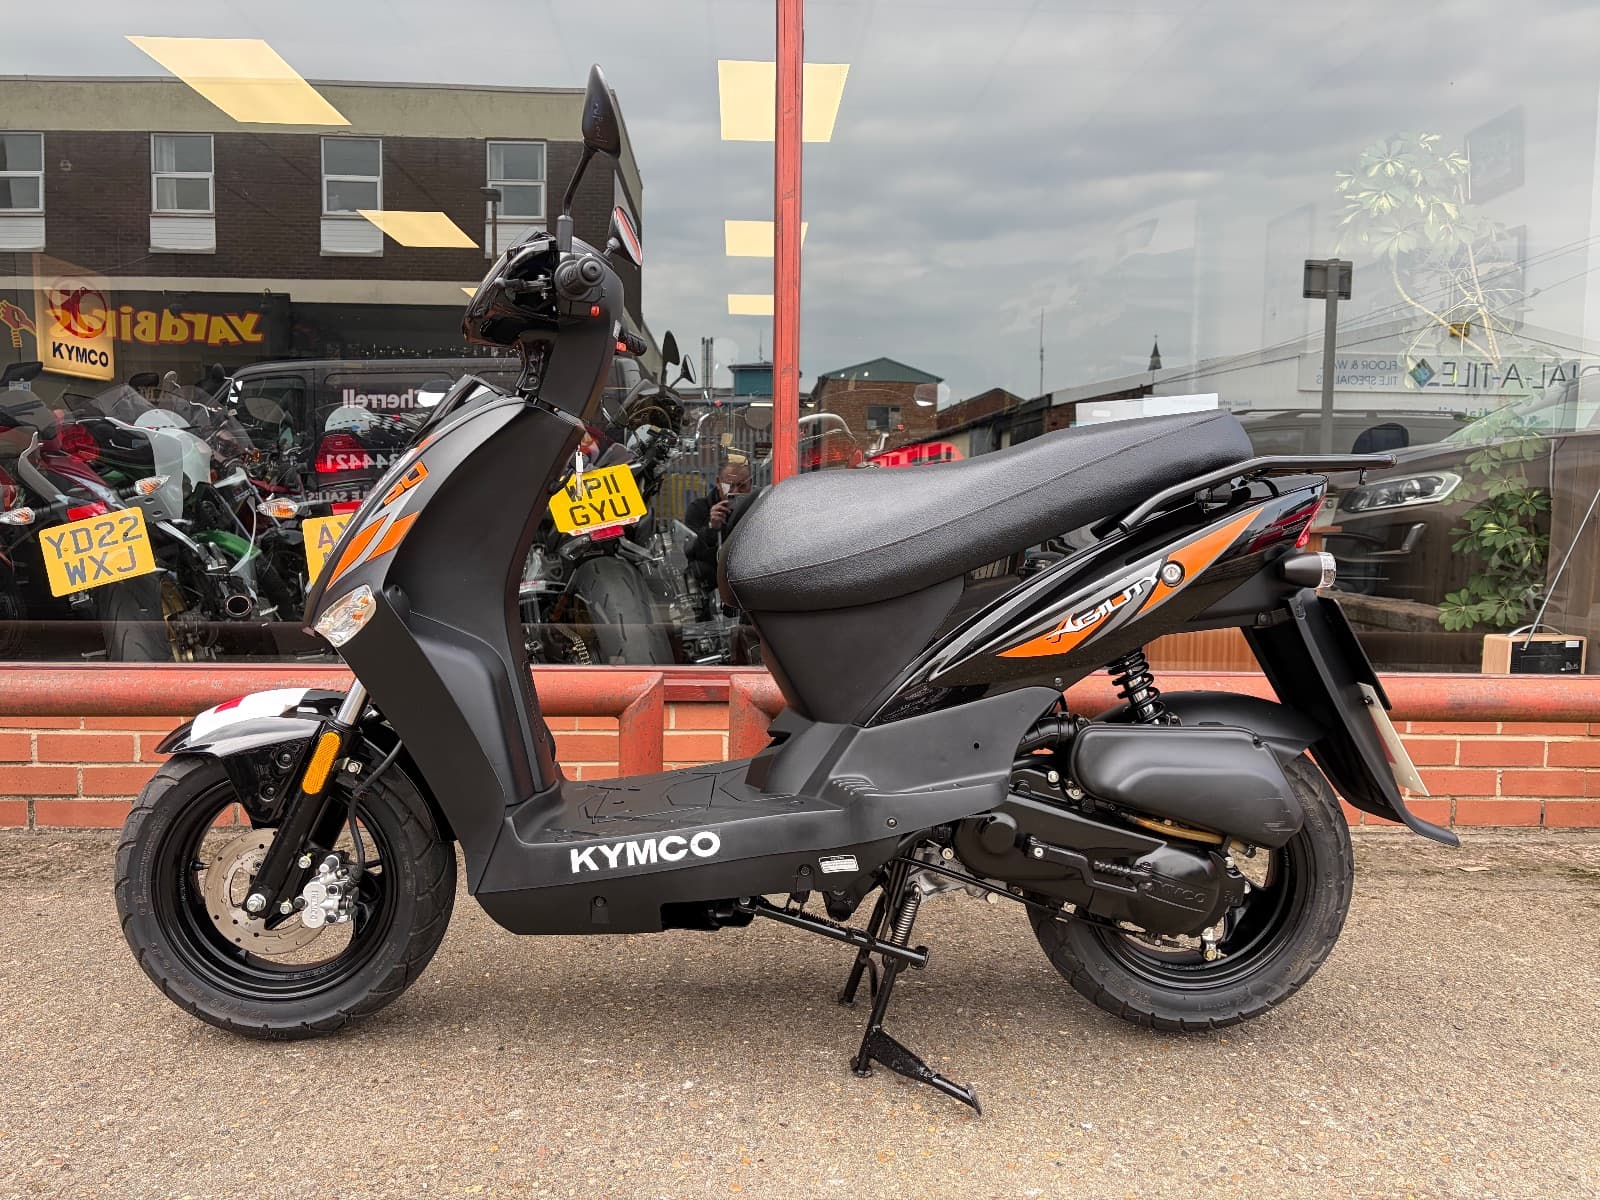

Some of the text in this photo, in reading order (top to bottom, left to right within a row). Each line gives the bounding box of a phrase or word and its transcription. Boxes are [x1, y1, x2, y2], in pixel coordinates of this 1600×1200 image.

[52, 341, 109, 368] KYMCO
[569, 496, 631, 527] GYU
[44, 514, 143, 560] YD22
[64, 545, 137, 587] WXJ
[570, 831, 721, 874] KYMCO
